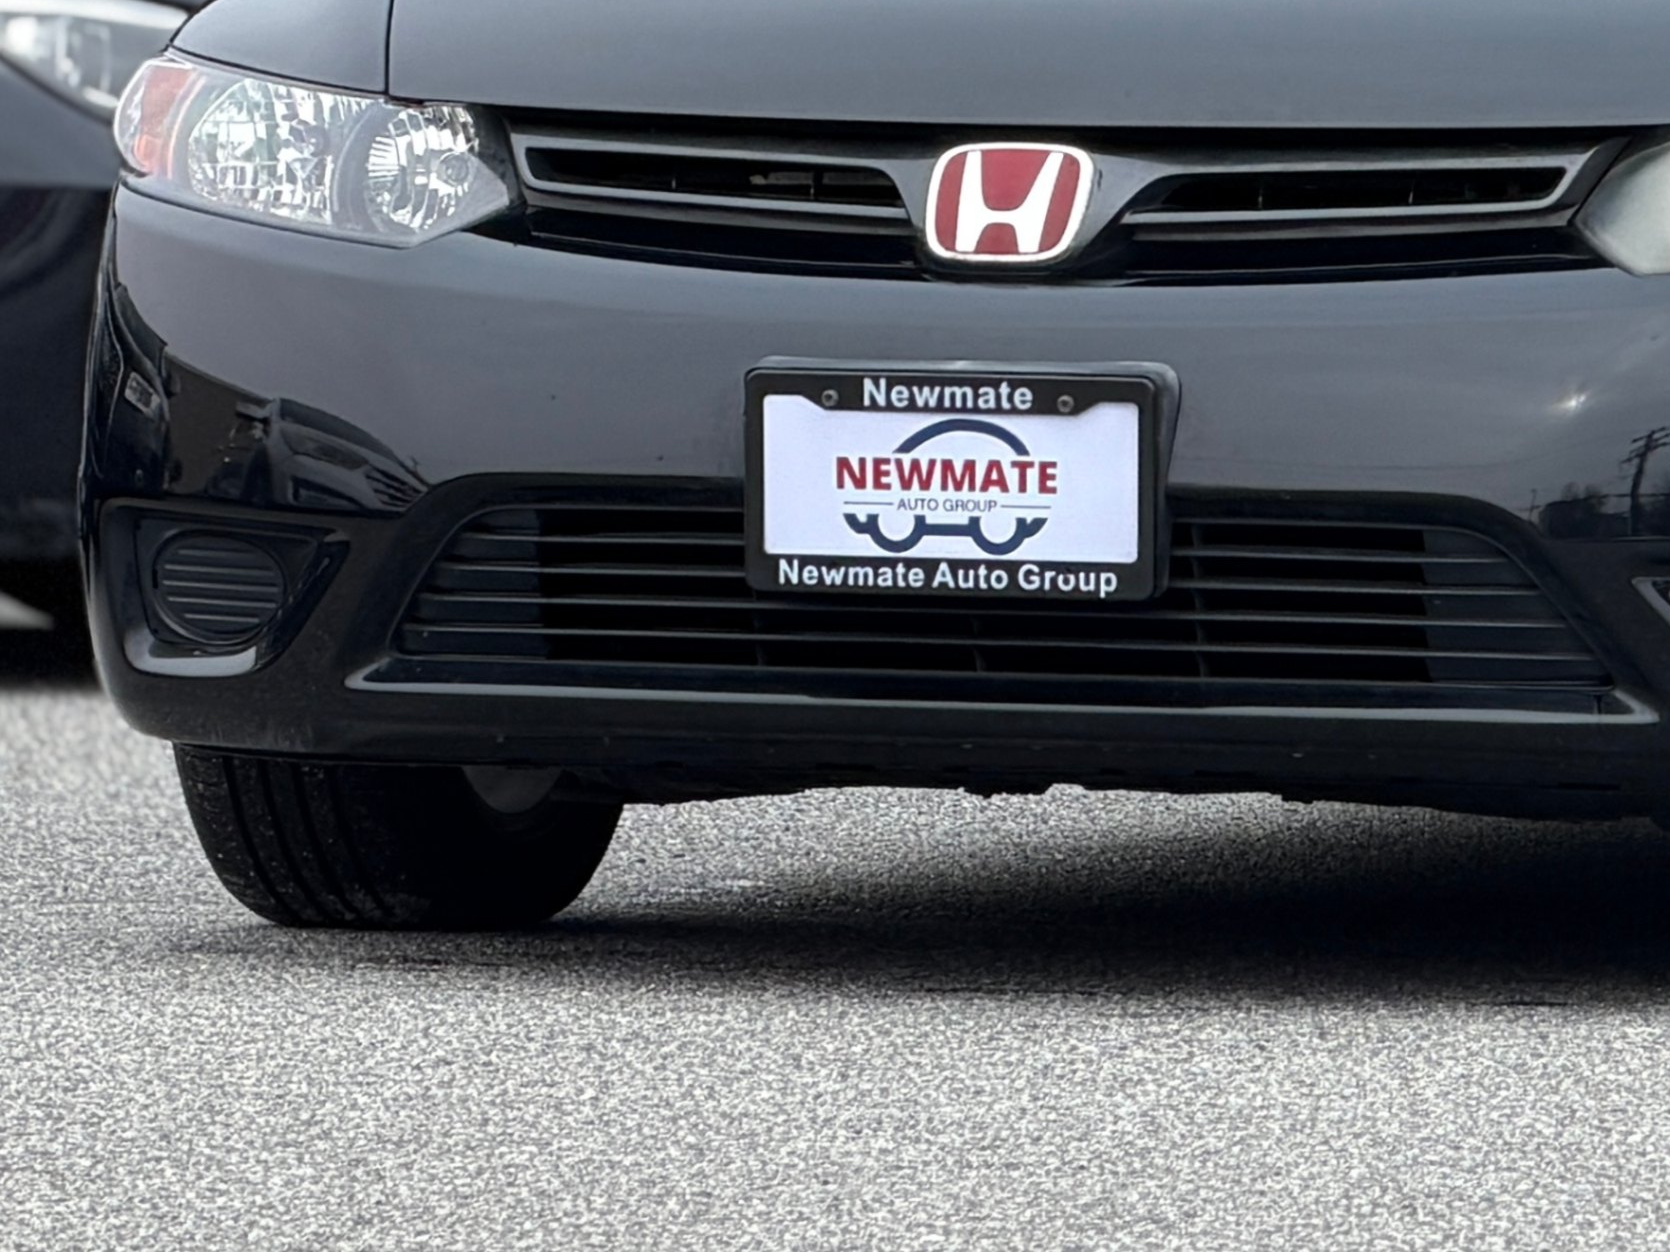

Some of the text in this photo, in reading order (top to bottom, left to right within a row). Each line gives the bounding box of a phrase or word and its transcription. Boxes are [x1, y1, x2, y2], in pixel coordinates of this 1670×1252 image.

[863, 377, 1033, 410] Newmate
[836, 456, 1058, 495] NEWMATE
[897, 498, 998, 513] AUTO GROUP
[778, 559, 1118, 598] Newmate Auto Group
